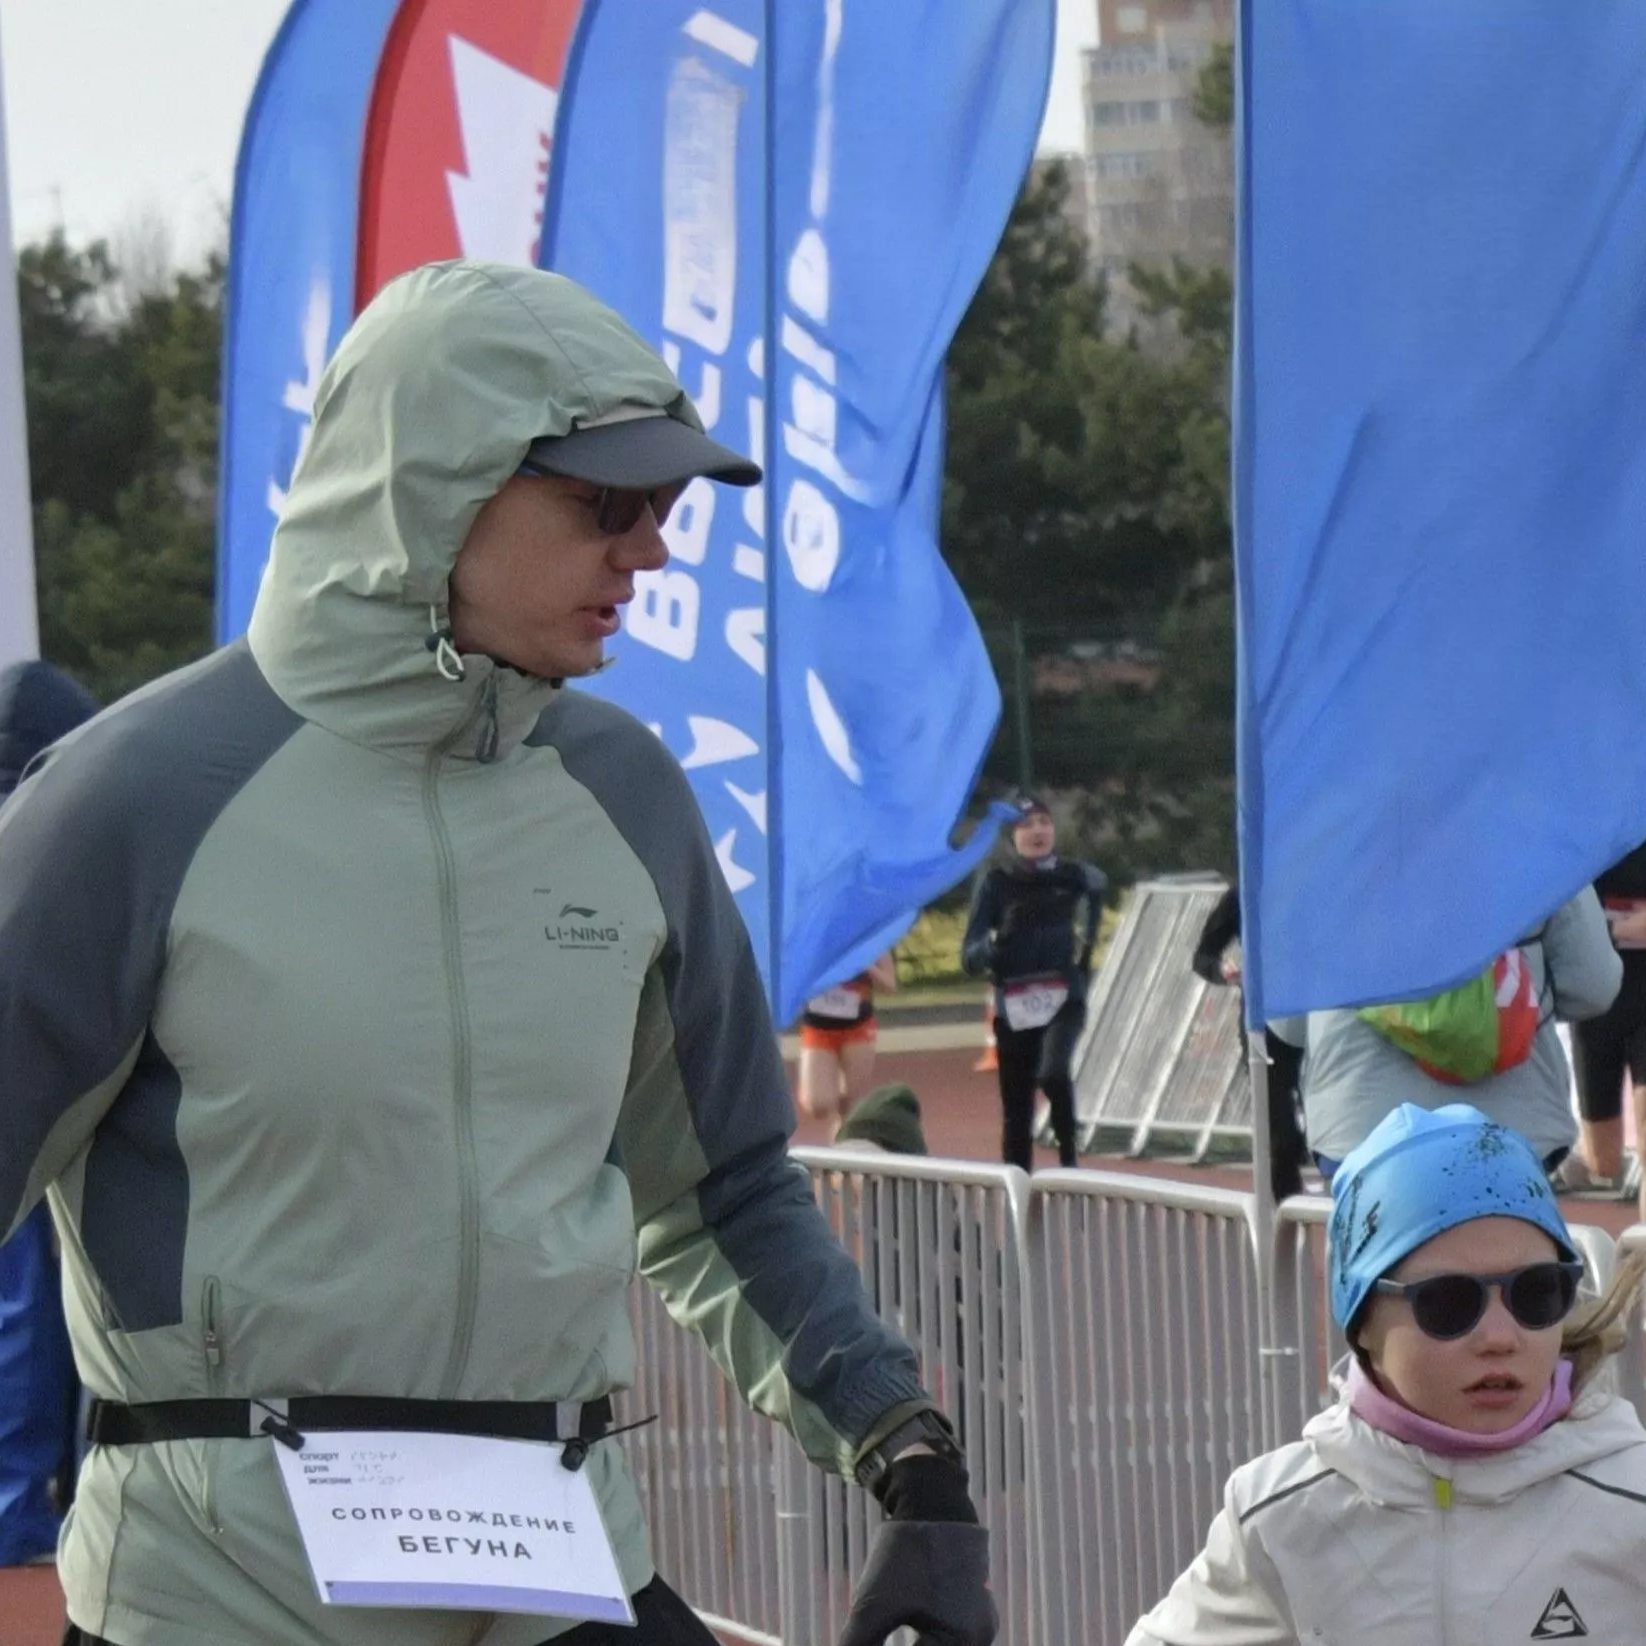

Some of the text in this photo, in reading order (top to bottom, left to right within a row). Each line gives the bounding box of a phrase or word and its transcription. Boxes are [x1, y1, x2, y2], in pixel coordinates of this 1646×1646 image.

[544, 926, 619, 942] LI-NING
[331, 1507, 577, 1534] СОПРОВОЖДЕНИЕ
[398, 1535, 533, 1560] БЕГУНА
